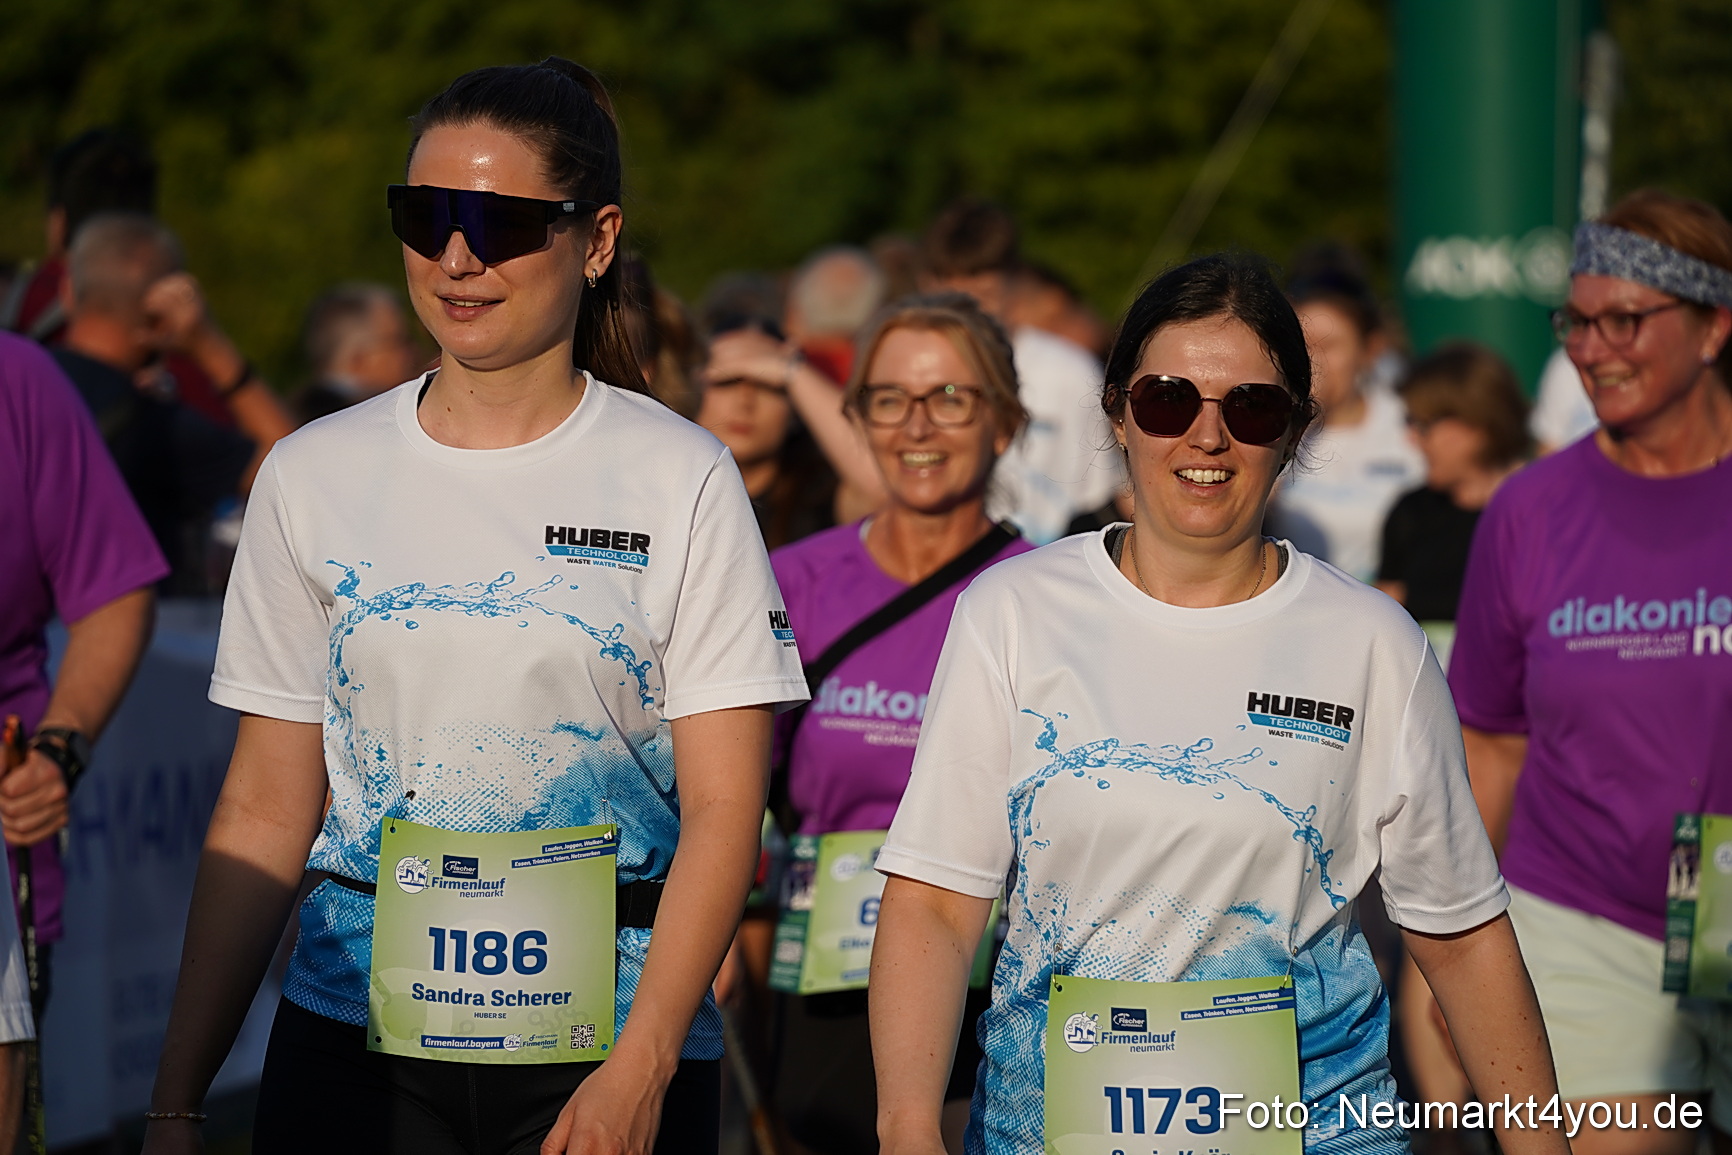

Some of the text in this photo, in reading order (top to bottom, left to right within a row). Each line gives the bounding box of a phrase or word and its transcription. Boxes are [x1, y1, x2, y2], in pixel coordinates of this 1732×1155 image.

[545, 525, 650, 555] HUBER
[566, 547, 645, 564] TECHNOLOGY
[567, 557, 643, 574] WASTE WATER Solutions
[768, 611, 792, 629] HU
[1549, 587, 1732, 638] diakonie
[781, 631, 795, 639] TEC
[1247, 691, 1355, 731] HUBER
[1269, 717, 1348, 740] TECHNOLOGY
[1268, 729, 1345, 752] WASTE WATER Solutions
[450, 863, 476, 872] Fischer
[431, 877, 506, 890] Firmenlauf
[459, 889, 504, 898] neumarkt
[429, 926, 548, 976] 1186
[411, 982, 572, 1007] Sandra Scherer
[1118, 1017, 1145, 1025] Fischer
[424, 1038, 500, 1050] firmenlauf.bayern
[522, 1039, 558, 1047] Firmenlauf
[1101, 1030, 1176, 1044] Firmenlauf
[1130, 1043, 1175, 1053] neumarkt
[1104, 1086, 1221, 1135] 1173
